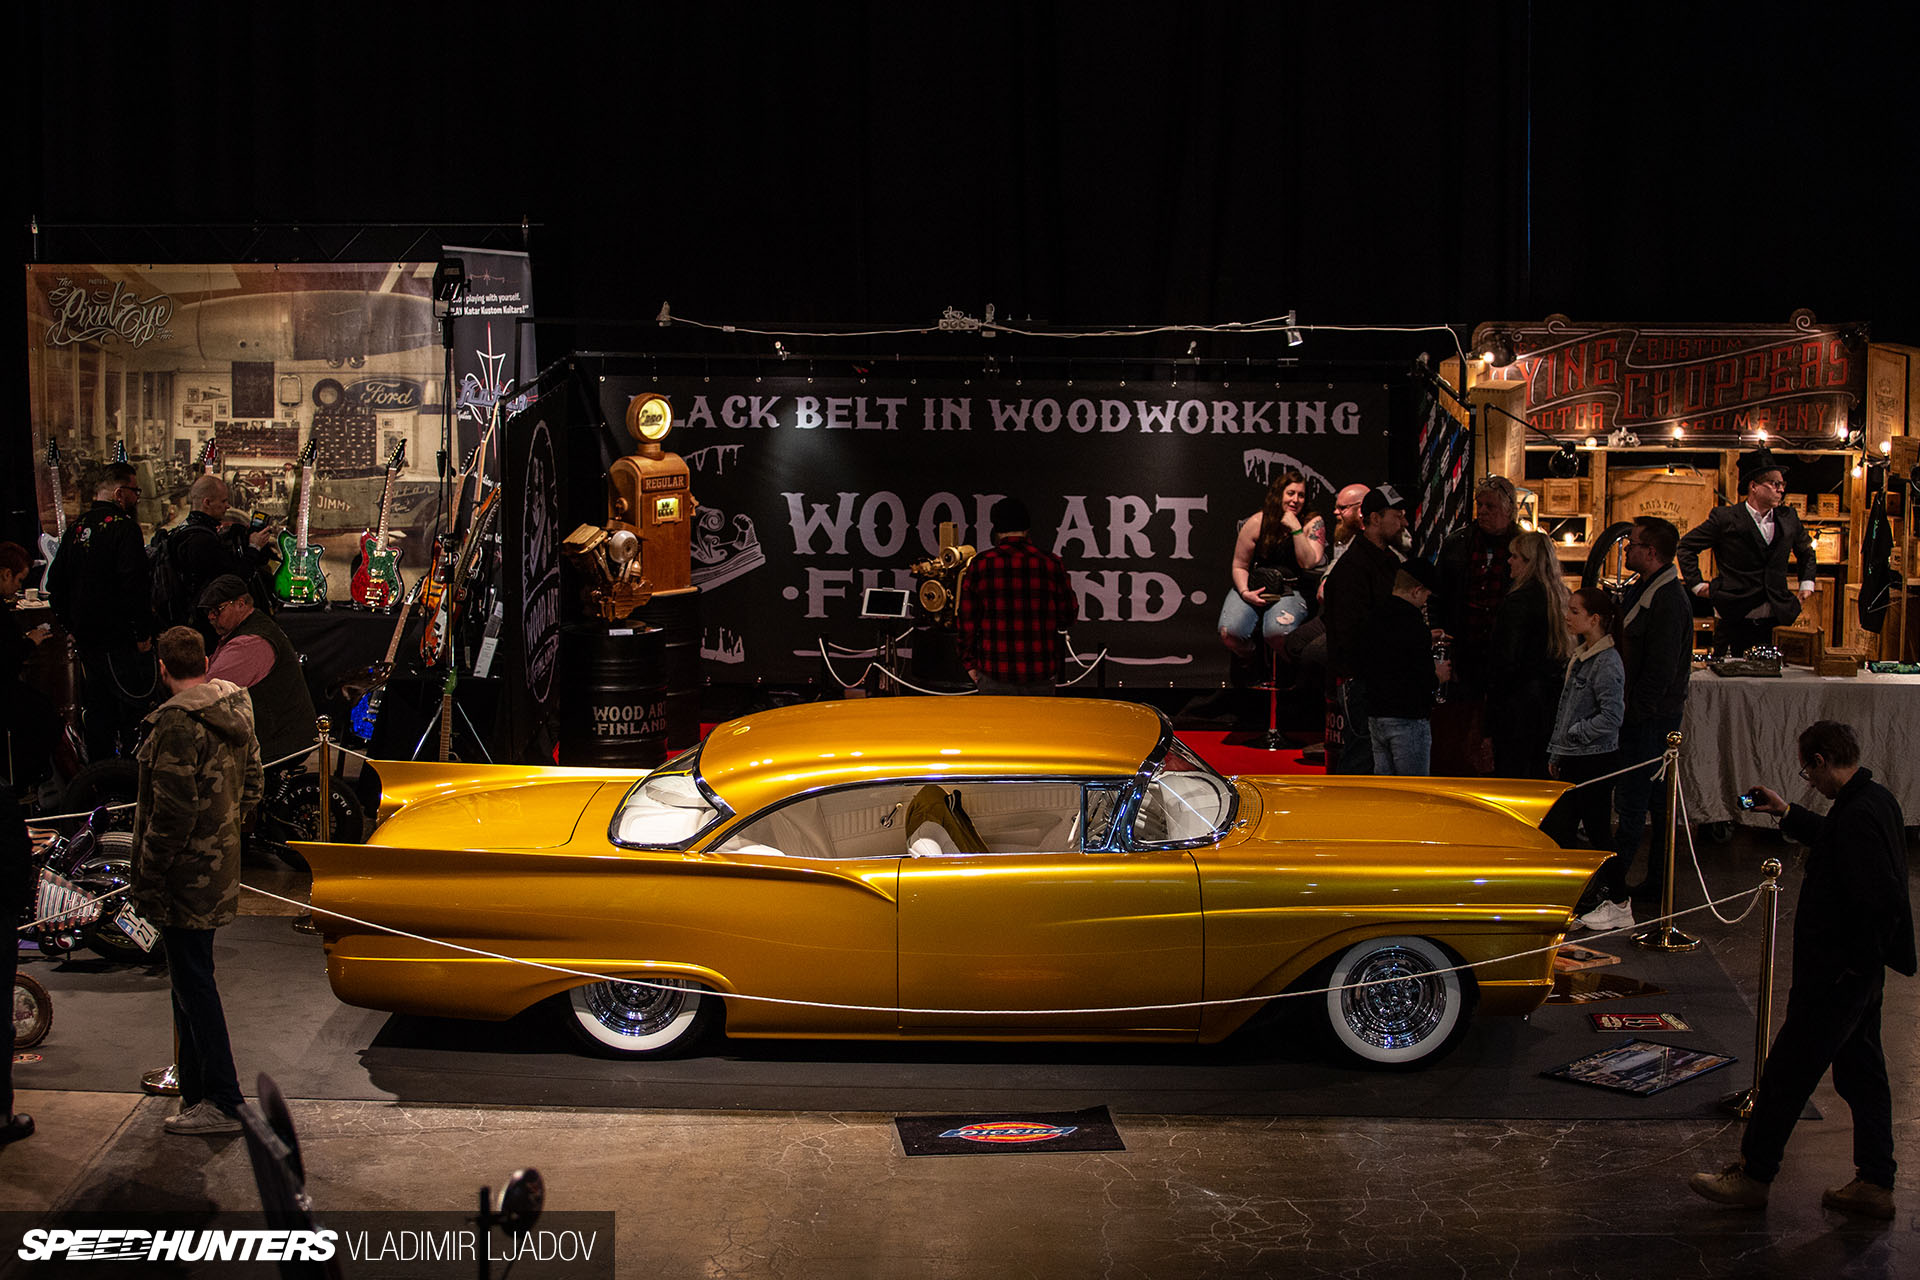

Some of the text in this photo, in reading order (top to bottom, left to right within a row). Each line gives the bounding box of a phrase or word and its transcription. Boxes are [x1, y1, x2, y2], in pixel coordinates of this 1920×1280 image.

[485, 293, 498, 302] with
[480, 305, 502, 314] Kustom
[1647, 336, 1742, 361] CUSTOM
[1489, 338, 1620, 407] YING
[1624, 339, 1850, 418] CHOPPERS
[360, 382, 414, 404] Ford
[628, 395, 1362, 436] ACK BELT IN WOODWORKING
[1692, 402, 1829, 431] COMPANY
[645, 476, 685, 489] REGULAR
[316, 495, 351, 512] JIMMY
[1051, 493, 1209, 561] ART
[592, 705, 645, 722] WOOD
[596, 717, 667, 736] FINLAND
